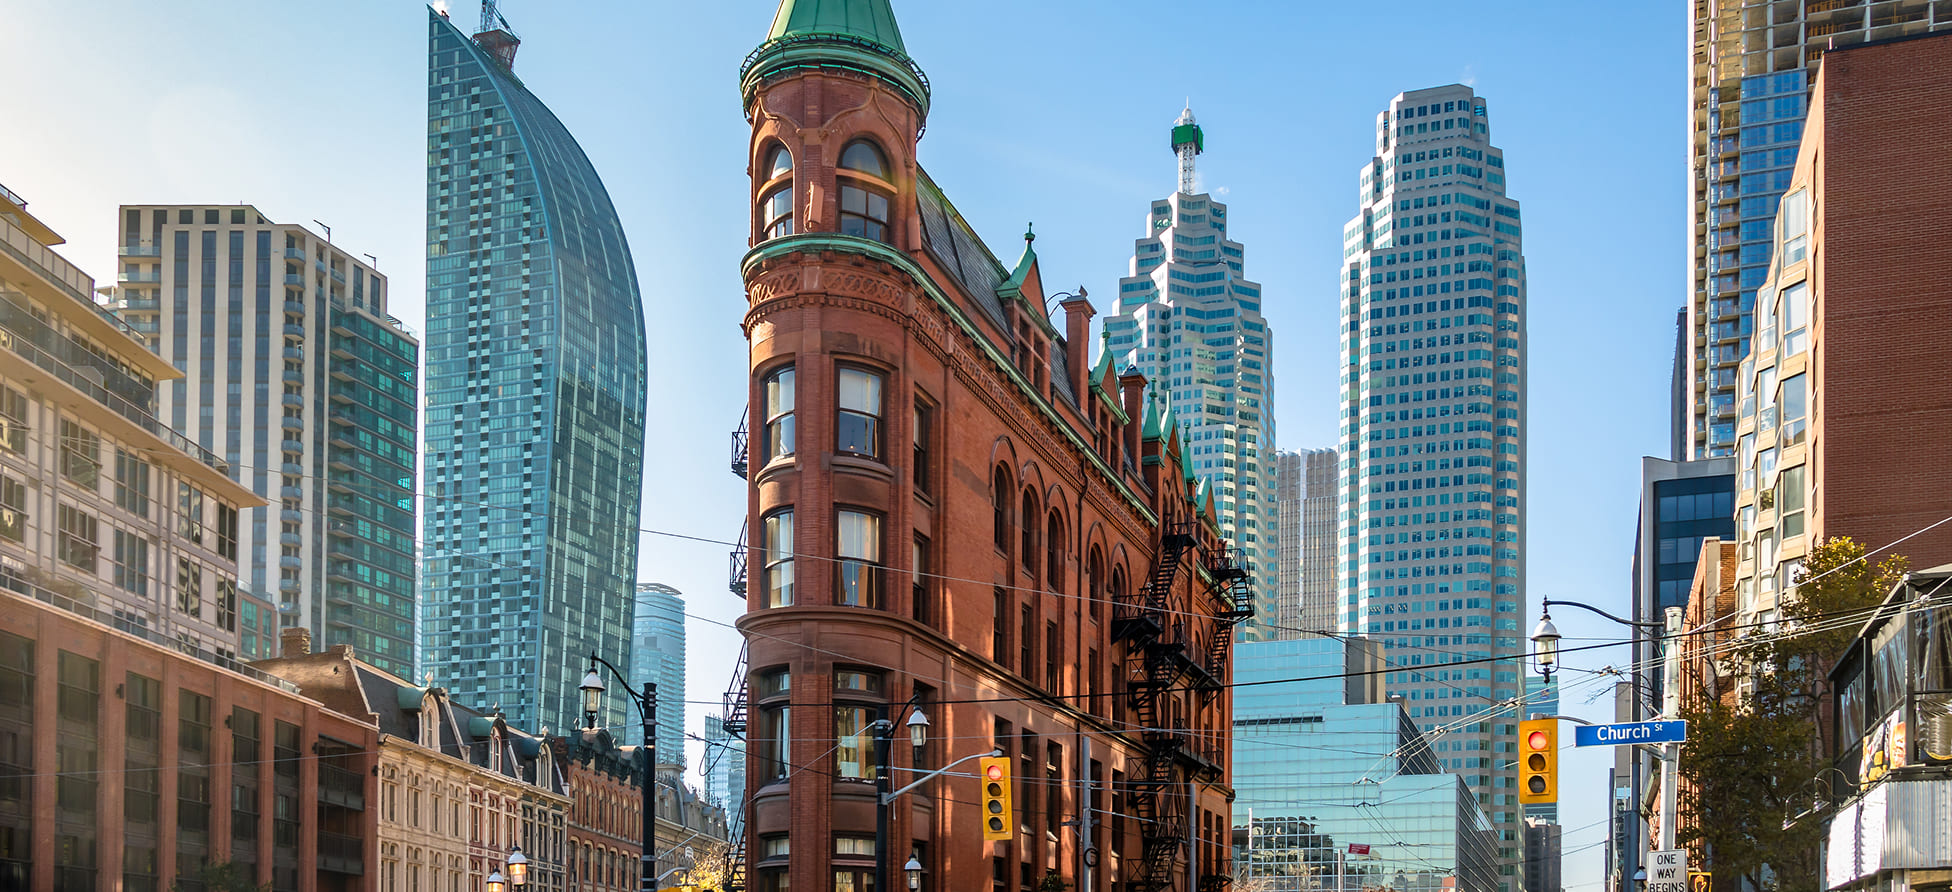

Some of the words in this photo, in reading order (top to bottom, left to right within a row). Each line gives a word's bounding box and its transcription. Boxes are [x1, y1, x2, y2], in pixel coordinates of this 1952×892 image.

[1597, 724, 1650, 740] Church
[1654, 723, 1663, 731] St
[1656, 853, 1677, 865] ONE
[1656, 867, 1676, 879] WAY
[1649, 882, 1685, 892] BEGINS
